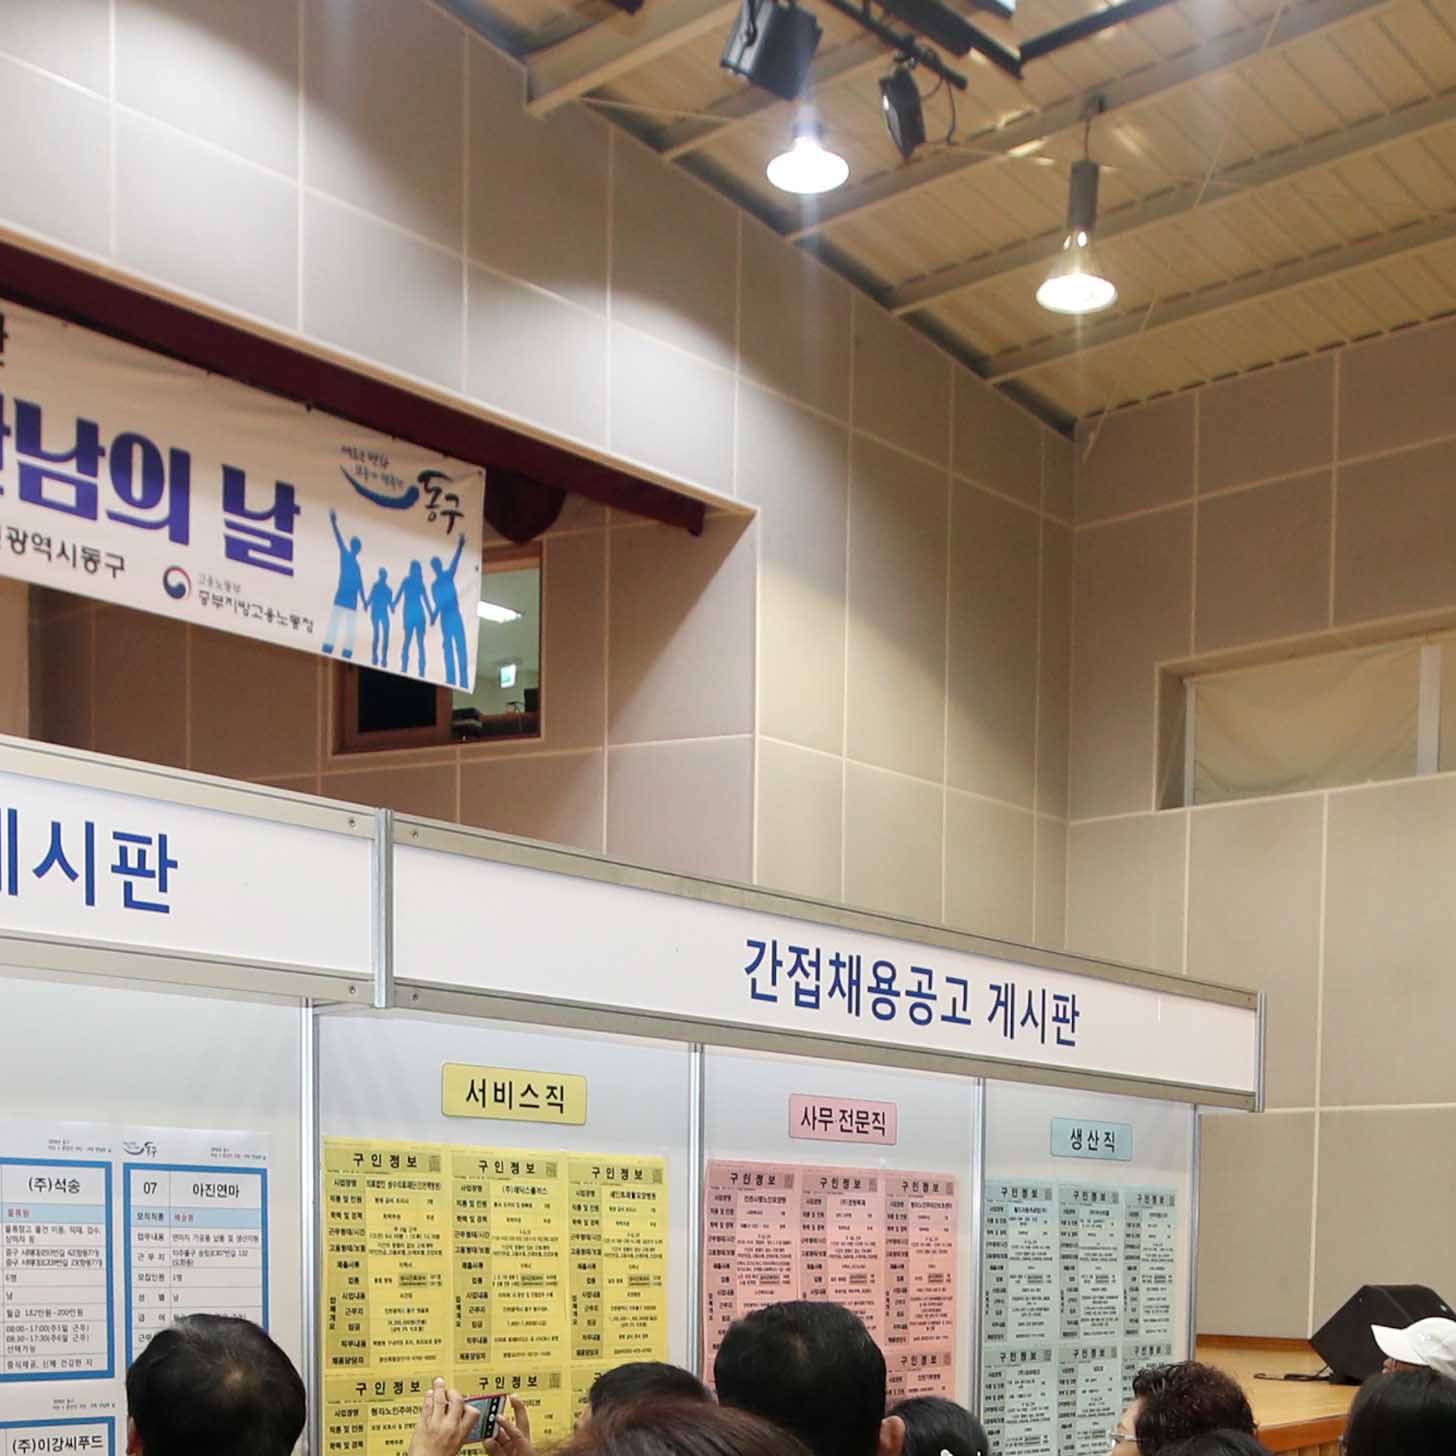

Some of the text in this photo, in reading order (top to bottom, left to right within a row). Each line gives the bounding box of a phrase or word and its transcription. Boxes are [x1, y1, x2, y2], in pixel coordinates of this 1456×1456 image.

[221, 464, 301, 577] 날
[743, 938, 1080, 1048] 간접채용공고 게시판
[465, 1078, 565, 1114] 서비스직
[1070, 1127, 1116, 1153] 생산직
[28, 1177, 80, 1194] (주)석송
[144, 1182, 157, 1194] 07
[193, 1184, 239, 1198] 아진연마
